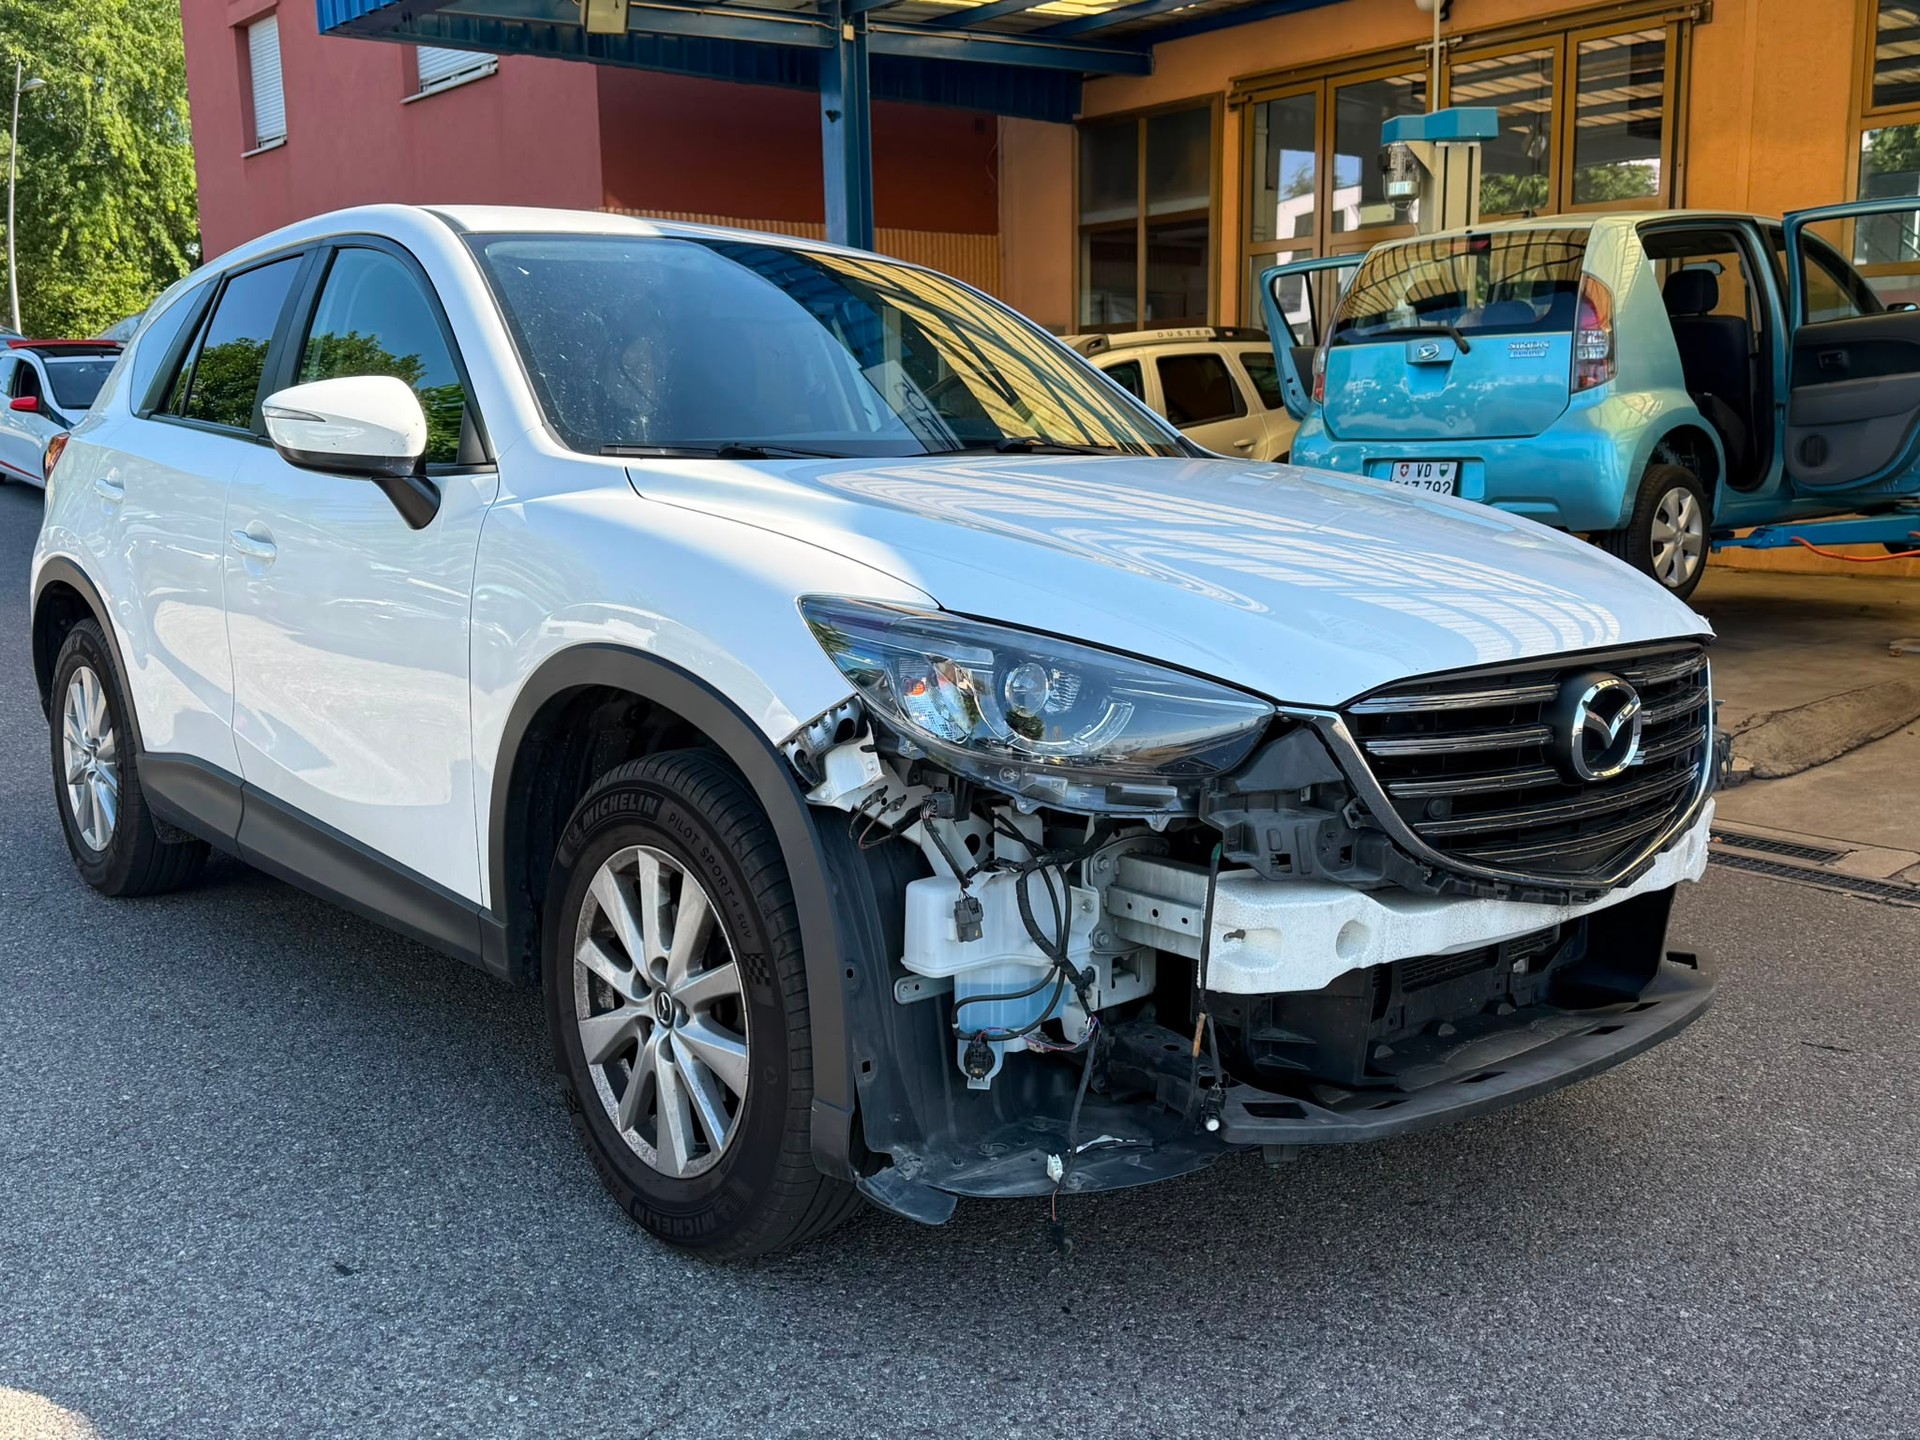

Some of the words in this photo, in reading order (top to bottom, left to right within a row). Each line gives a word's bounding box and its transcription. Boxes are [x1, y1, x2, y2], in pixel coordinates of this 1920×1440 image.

[1157, 329, 1211, 338] DUSTER
[1417, 463, 1432, 478] VD
[582, 793, 658, 827] MICHELIN
[667, 811, 701, 846] PILOT
[700, 846, 736, 898] SPORT
[736, 912, 753, 939] SUV
[632, 1201, 717, 1238] MICHELIN
